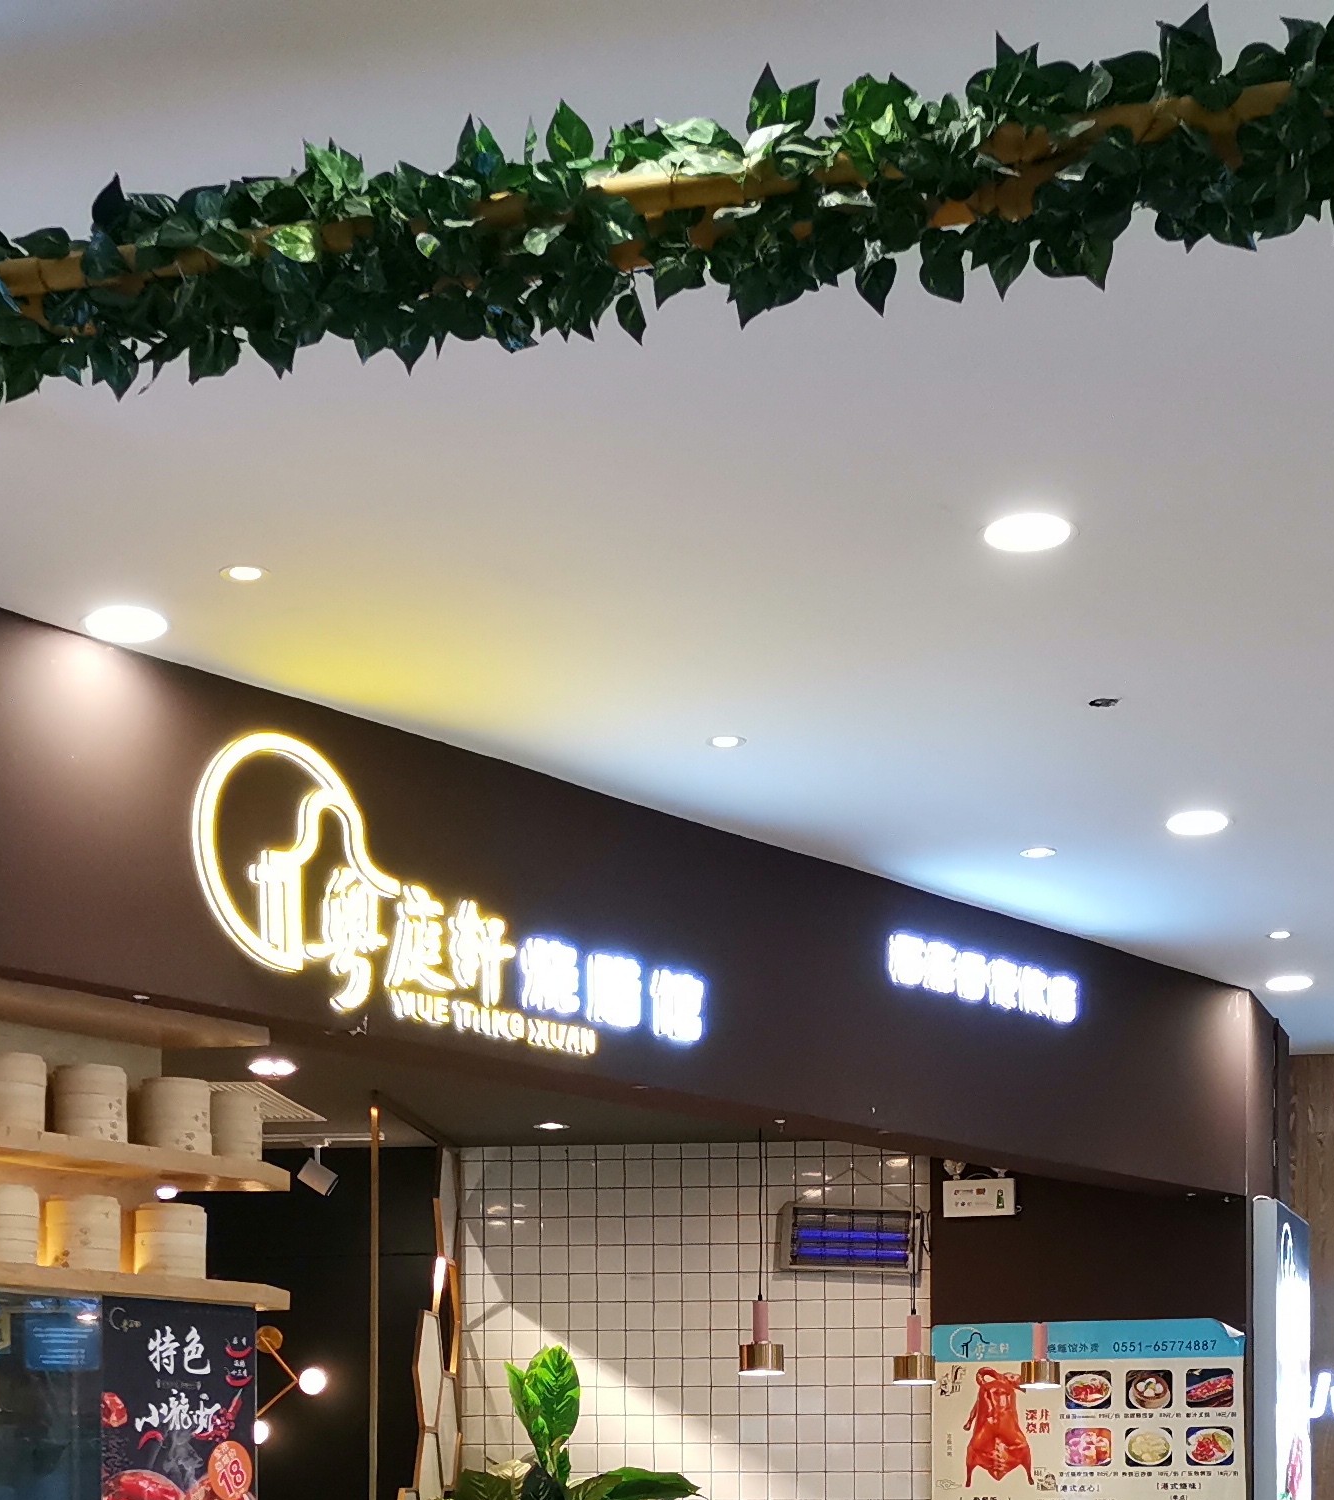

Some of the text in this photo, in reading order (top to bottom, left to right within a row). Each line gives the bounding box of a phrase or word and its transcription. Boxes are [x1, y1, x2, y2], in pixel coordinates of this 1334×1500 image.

[147, 1326, 212, 1375] 特色
[1113, 1340, 1217, 1353] 0551-65774887
[1025, 1409, 1050, 1421] 深井
[219, 1459, 246, 1497] 18
